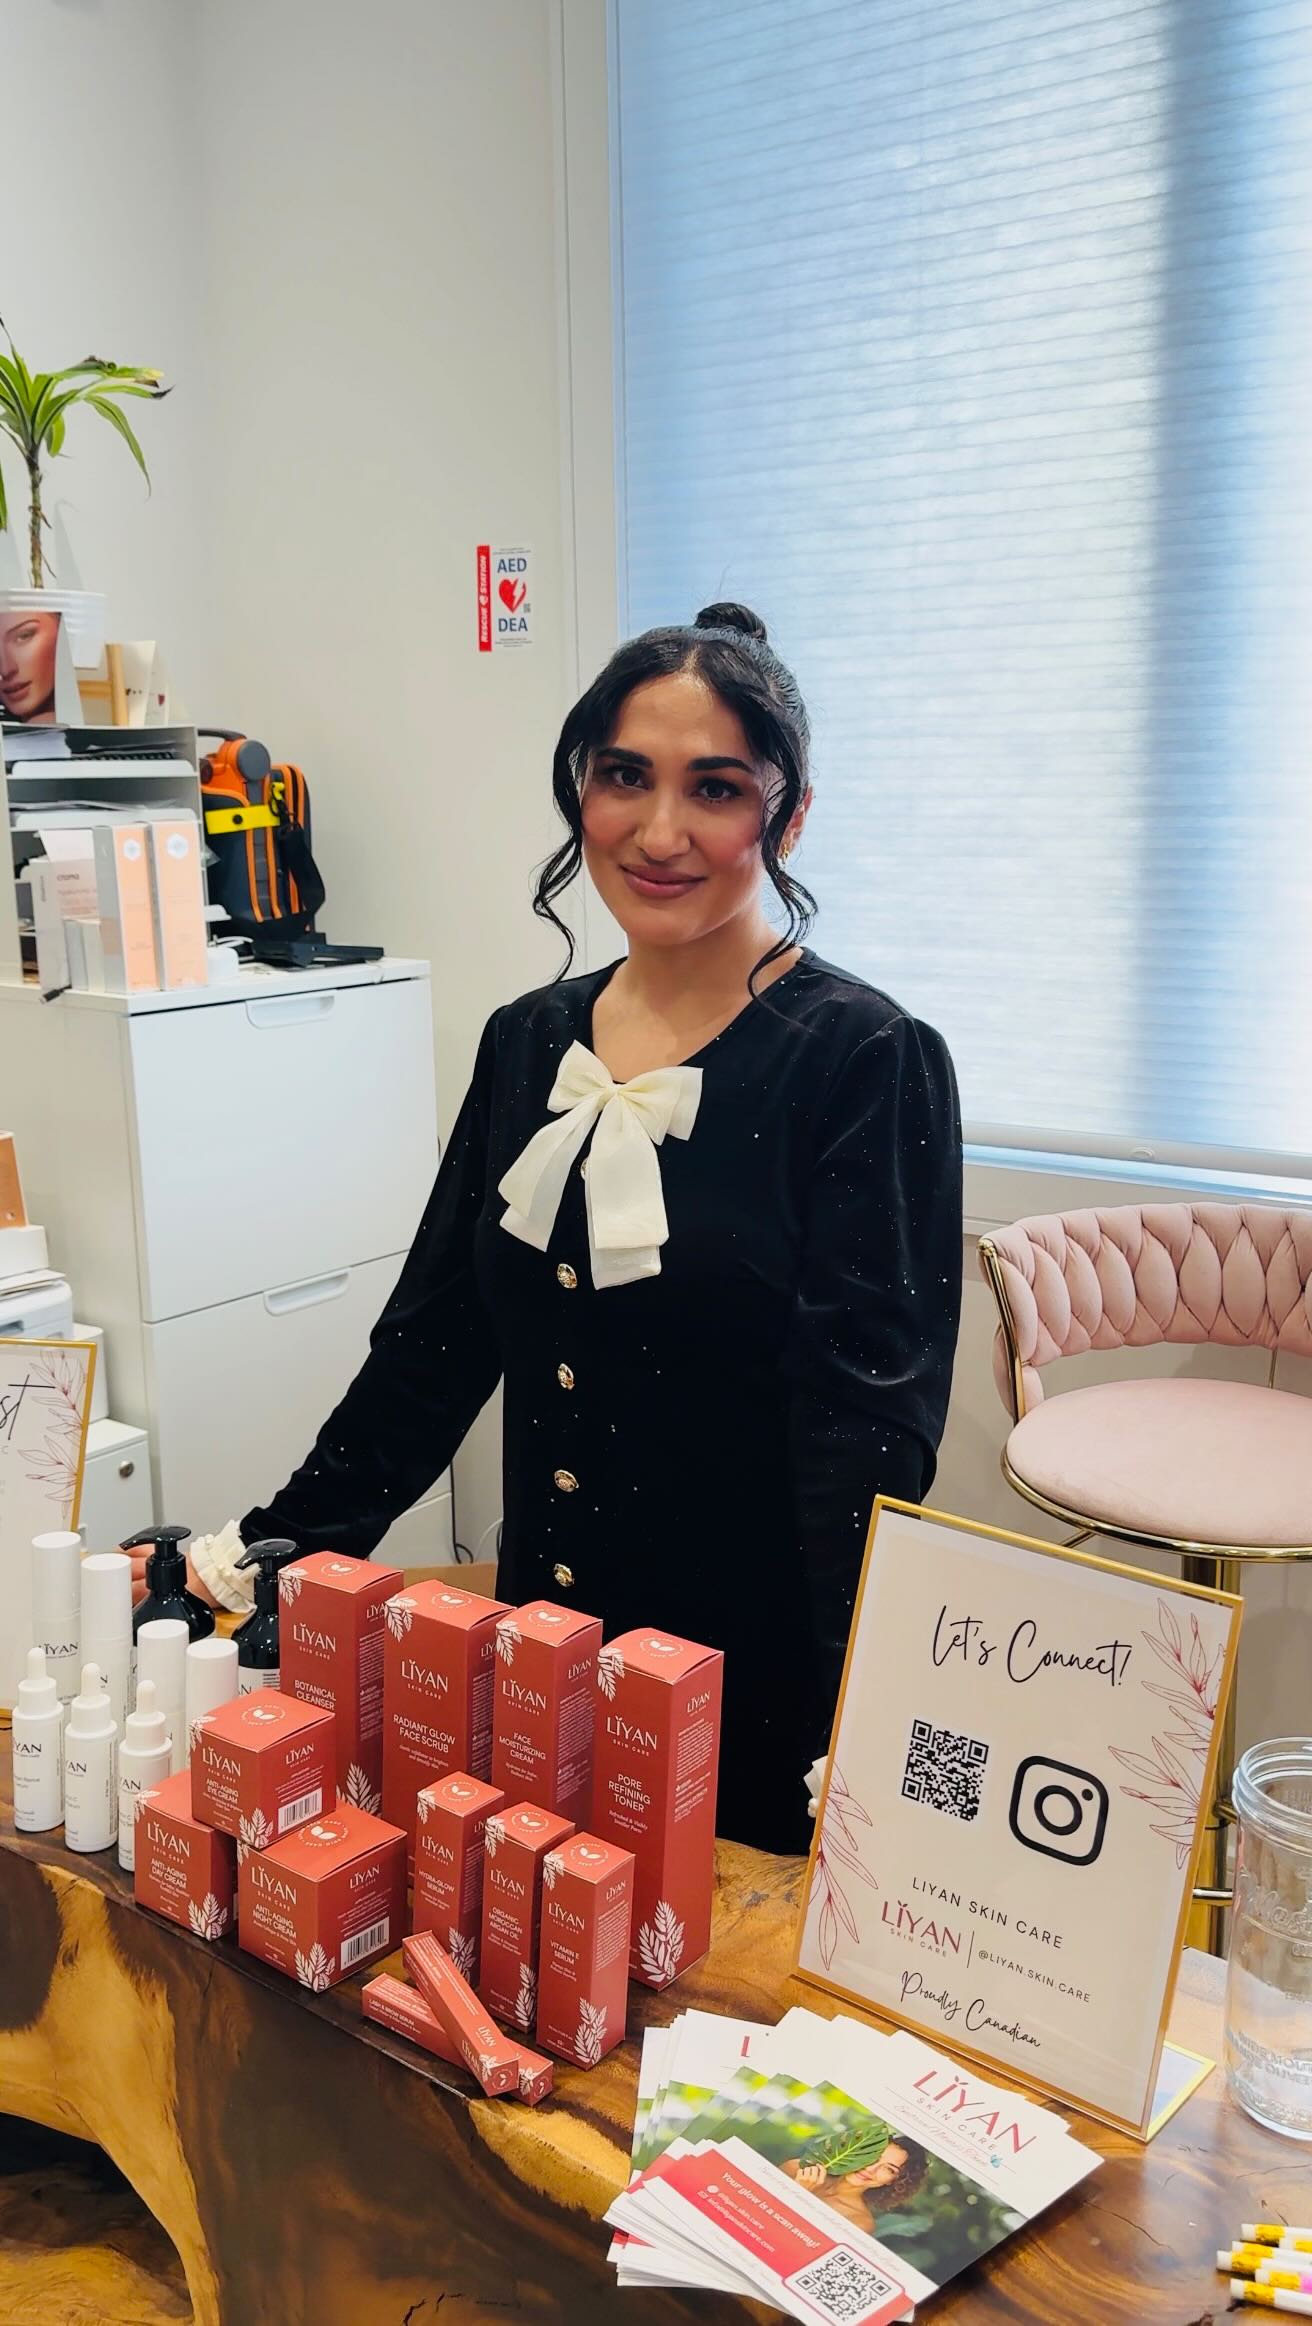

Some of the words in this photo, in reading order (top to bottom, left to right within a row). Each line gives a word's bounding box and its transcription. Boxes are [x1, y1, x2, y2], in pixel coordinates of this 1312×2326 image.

[497, 558, 527, 573] AED
[498, 618, 528, 632] DEA
[932, 1605, 997, 1667] Let's
[1007, 1619, 1132, 1687] Connect!
[294, 1679, 336, 1702] BOTANICAL
[296, 1690, 335, 1711] CLEANSER
[393, 1714, 427, 1735] RADIANT
[429, 1728, 456, 1745] GLOW
[399, 1726, 421, 1743] FACE
[421, 1735, 449, 1753] SCRUB
[513, 1732, 532, 1746] FACE
[499, 1736, 546, 1760] MOISTURIZING
[510, 1750, 534, 1765] CREAM
[206, 1778, 239, 1797] ANTI-AGING
[608, 1780, 651, 1805] REFINING
[617, 1773, 642, 1791] PORE
[207, 1787, 217, 1796] EYE
[217, 1790, 238, 1804] CREAM
[614, 1793, 645, 1813] TONER
[151, 1858, 187, 1881] ANTI-AGING
[151, 1867, 164, 1878] DAY
[164, 1873, 186, 1889] CREAM
[419, 1870, 455, 1893] HYDRA-GLOW
[426, 1881, 445, 1896] SERUM
[255, 1903, 294, 1929] ANTI-AGING
[488, 1912, 523, 1935] MOROCCAN
[492, 1907, 519, 1925] ORGANIC
[912, 1876, 961, 1907] LIYAN
[968, 1901, 1008, 1926] SKIN
[1016, 1920, 1063, 1949] CARE
[252, 1910, 272, 1926] NIGHT
[272, 1921, 297, 1939] CREAM
[489, 1922, 509, 1936] ARGAN
[509, 1930, 520, 1941] OIL
[550, 1940, 574, 1958] VITAMIN
[890, 1928, 914, 1943] SKIN
[920, 1941, 948, 1958] CARE
[554, 1950, 575, 1966] SERUM
[978, 1949, 1091, 2003] @LIYAN.SKIN.CARE
[901, 1971, 962, 2020] Proudly
[965, 1998, 1041, 2048] Canadian
[916, 2097, 951, 2121] SKIN
[957, 2124, 997, 2151] CARE
[722, 2171, 741, 2191] Your
[740, 2183, 762, 2204] glow
[759, 2196, 769, 2210] is
[772, 2209, 795, 2233] scan
[791, 2224, 821, 2250] away!
